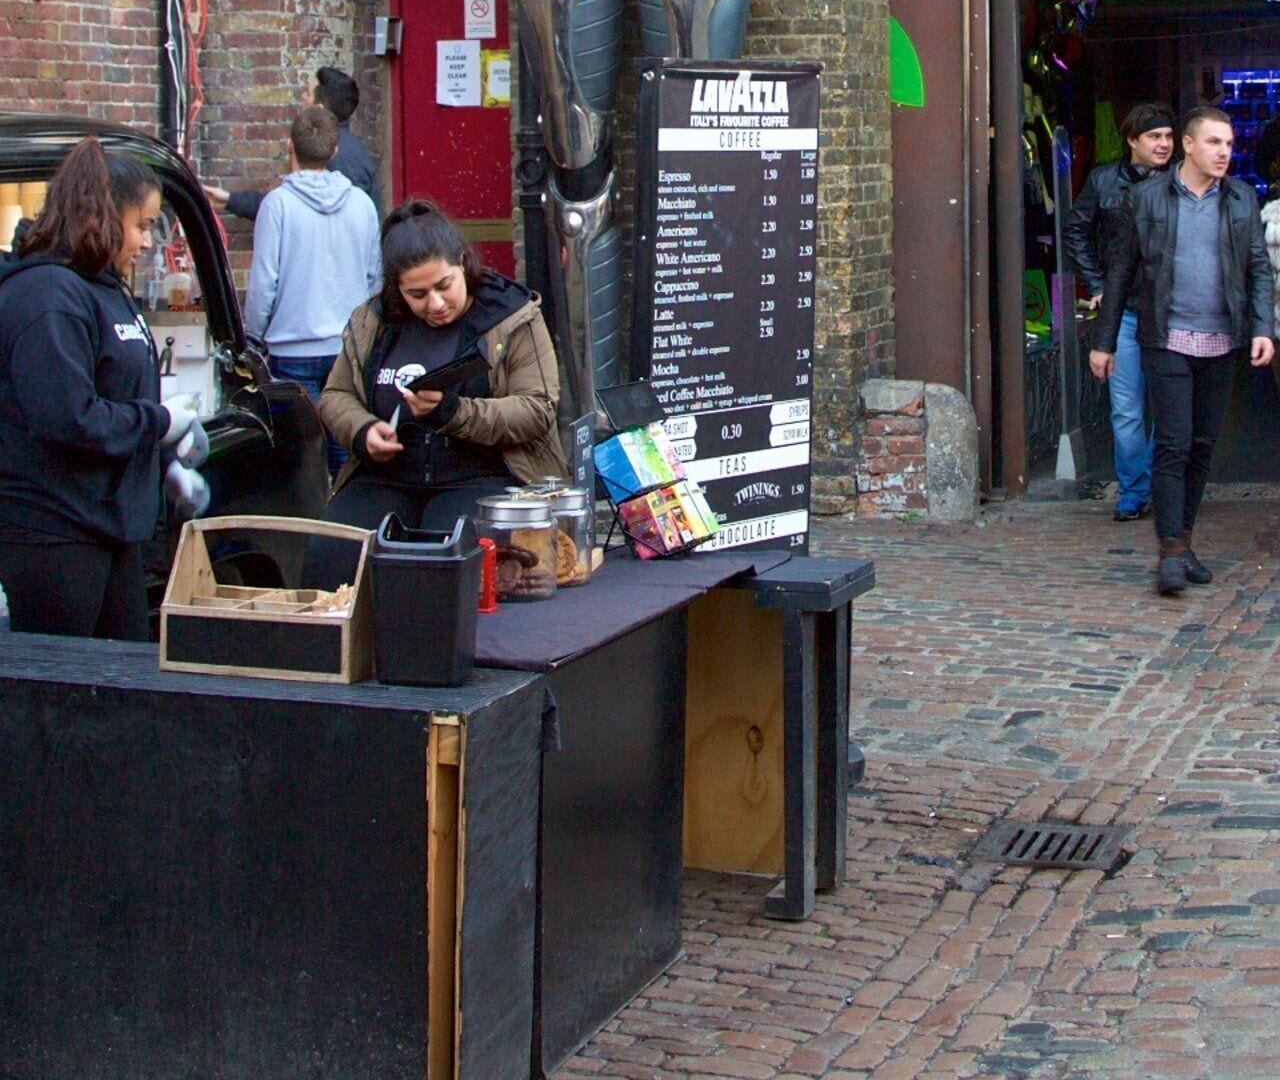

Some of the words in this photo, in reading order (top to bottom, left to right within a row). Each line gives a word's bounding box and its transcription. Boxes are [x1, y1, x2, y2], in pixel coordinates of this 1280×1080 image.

[690, 70, 790, 113] LAVAZZA
[690, 115, 718, 127] ITALY'S
[719, 115, 761, 127] FAVOURITE
[761, 115, 790, 127] COFFEE
[719, 131, 762, 148] COFFEE
[658, 169, 692, 185] Espresso
[763, 168, 778, 180] 1.50
[657, 197, 697, 210] Macchiato
[763, 195, 777, 206] 1.50
[656, 224, 698, 238] Americano
[656, 252, 680, 265] White
[680, 251, 721, 263] Americano
[799, 245, 813, 257] 2.50
[654, 278, 700, 295] Cappuccino
[653, 309, 674, 321] Latte
[797, 296, 812, 308] 2.50
[652, 336, 669, 349] Flat
[670, 334, 693, 347] White
[759, 326, 774, 338] 2.50
[651, 362, 680, 377] Mocha
[669, 388, 695, 402] Coffee
[695, 383, 734, 399] Macchiato
[721, 423, 743, 440] 0.30
[719, 456, 747, 476] TEAS
[734, 481, 781, 505] TWININGS
[791, 483, 805, 495] 1.50
[711, 519, 776, 547] CHOCOLATE
